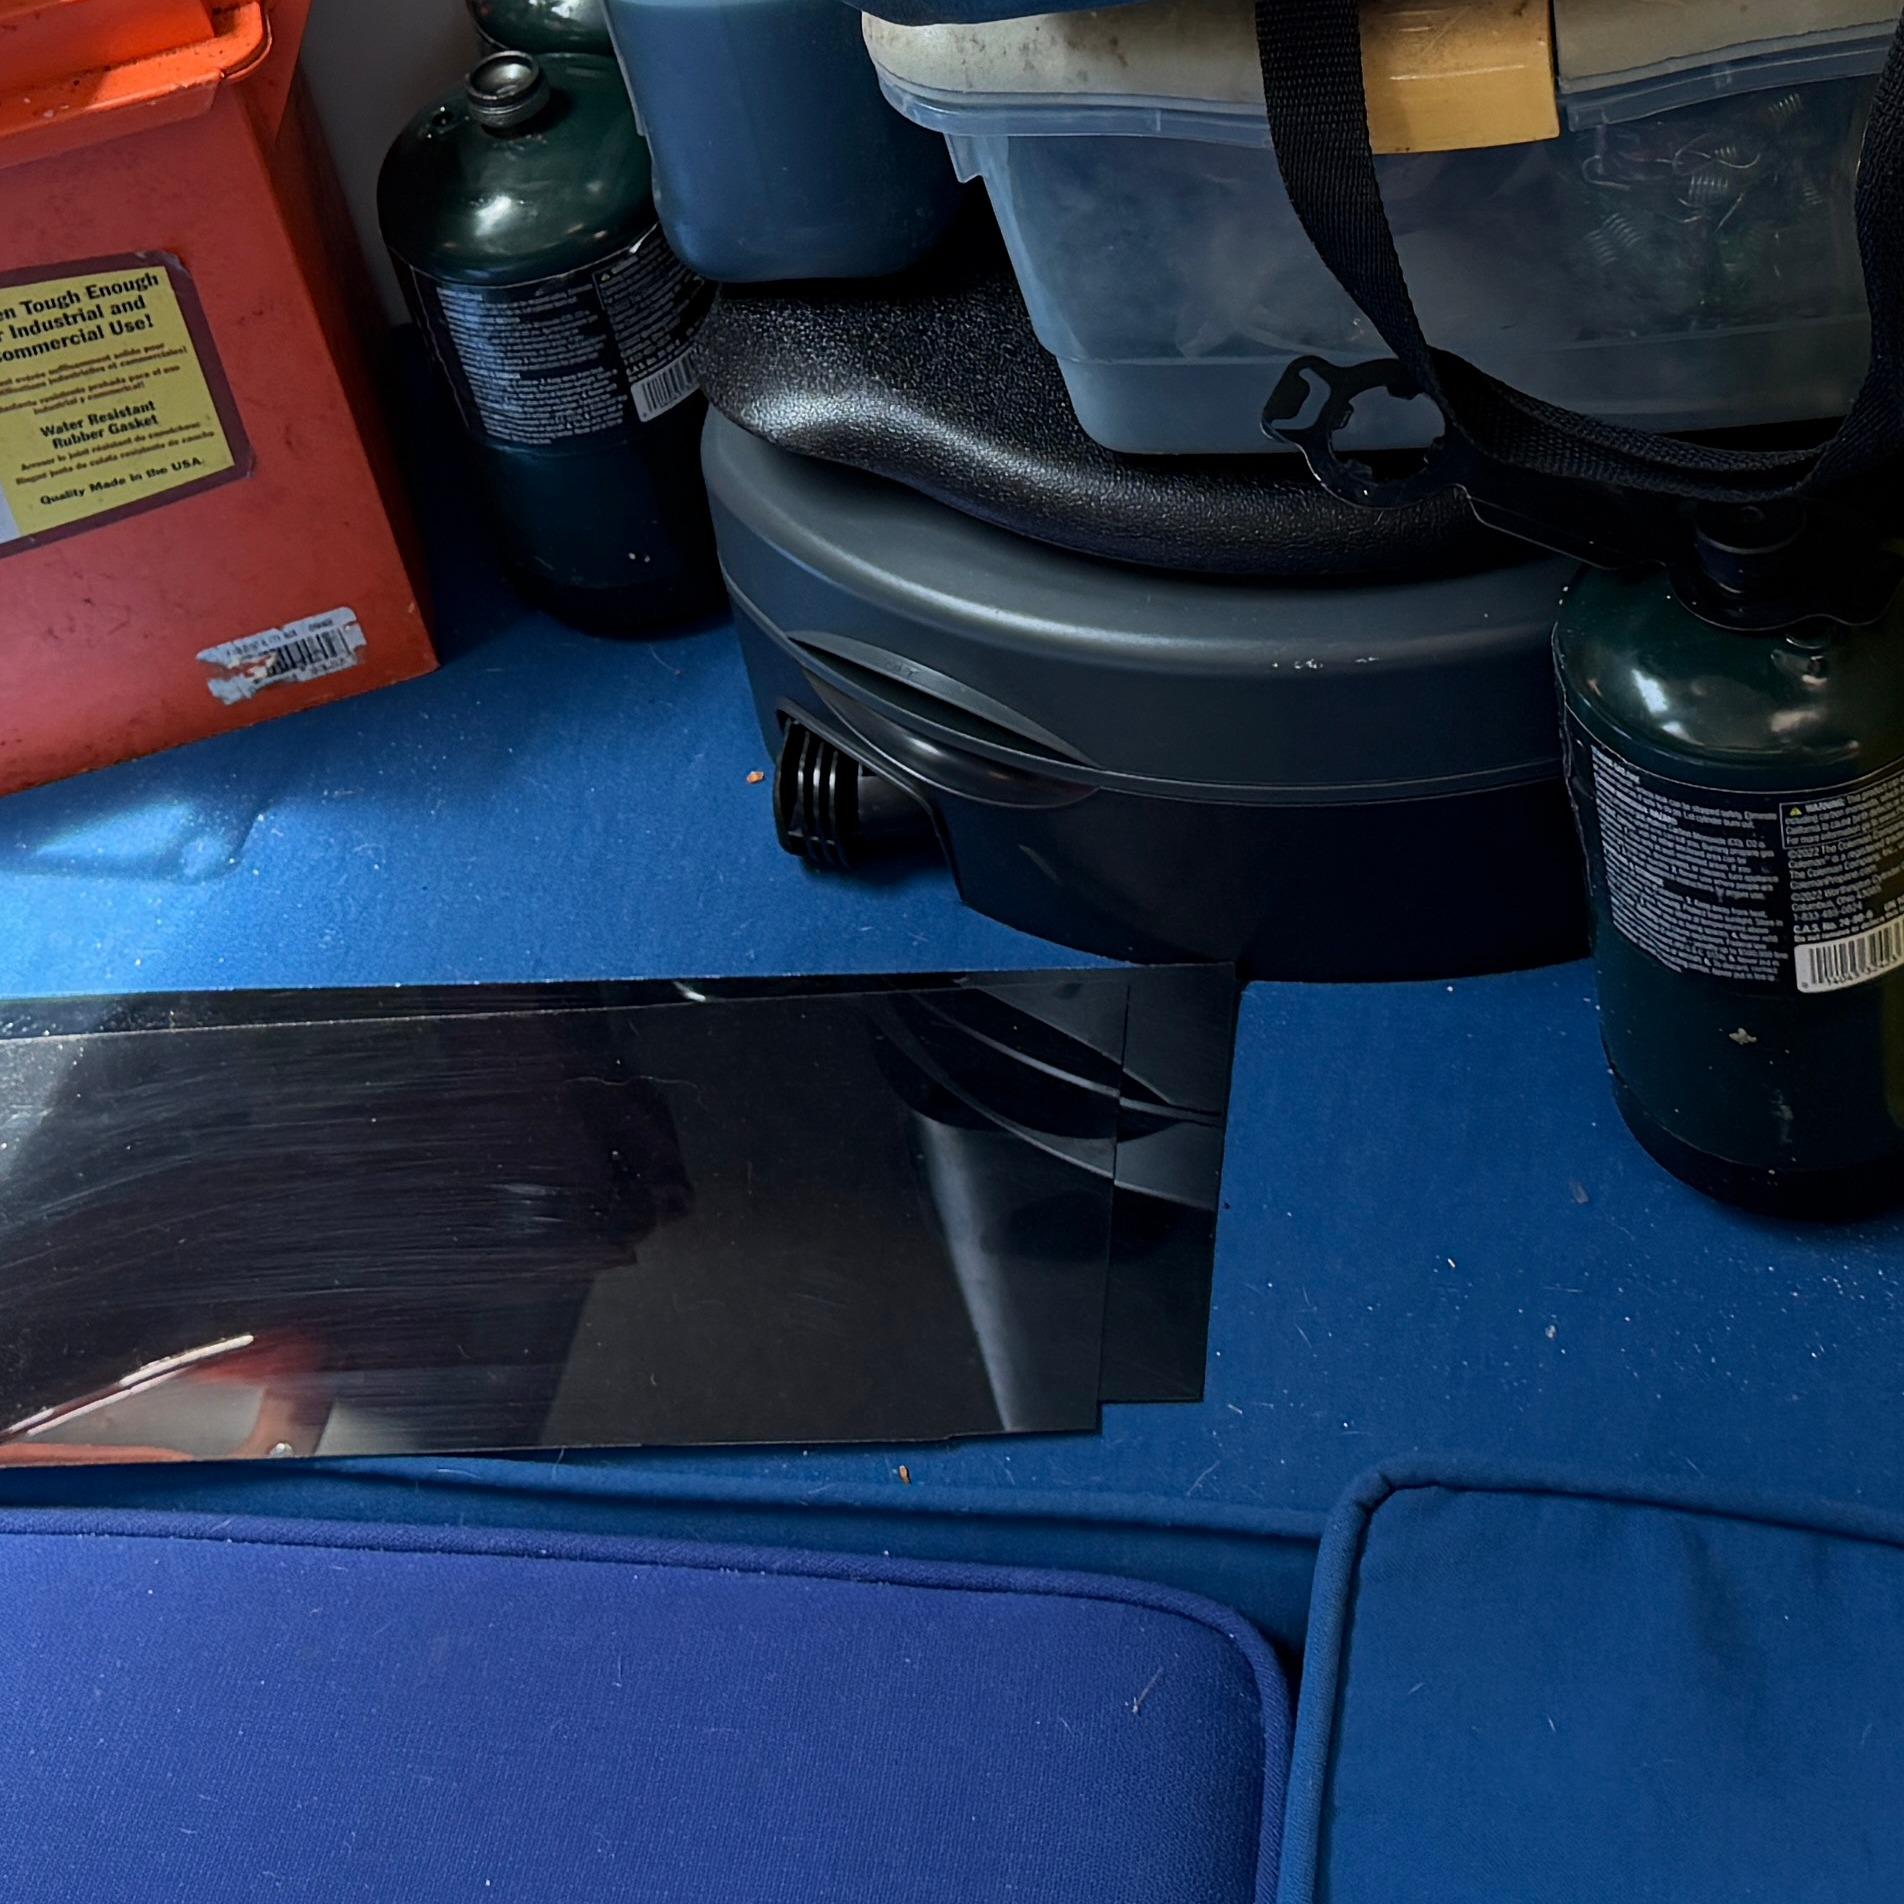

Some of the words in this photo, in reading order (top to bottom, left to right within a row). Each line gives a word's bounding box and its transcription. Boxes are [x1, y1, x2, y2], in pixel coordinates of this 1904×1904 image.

[19, 289, 82, 315] Tough
[85, 272, 160, 300] Enough
[9, 304, 105, 339] Industrial
[110, 294, 147, 313] and
[109, 313, 155, 336] Use!
[39, 419, 85, 438] Water
[87, 399, 157, 426] Resistant
[52, 428, 105, 451] Rubber
[108, 413, 160, 436] Gasket
[40, 486, 86, 506] Quality
[89, 476, 127, 493] Made
[129, 471, 144, 484] in
[146, 464, 169, 478] the
